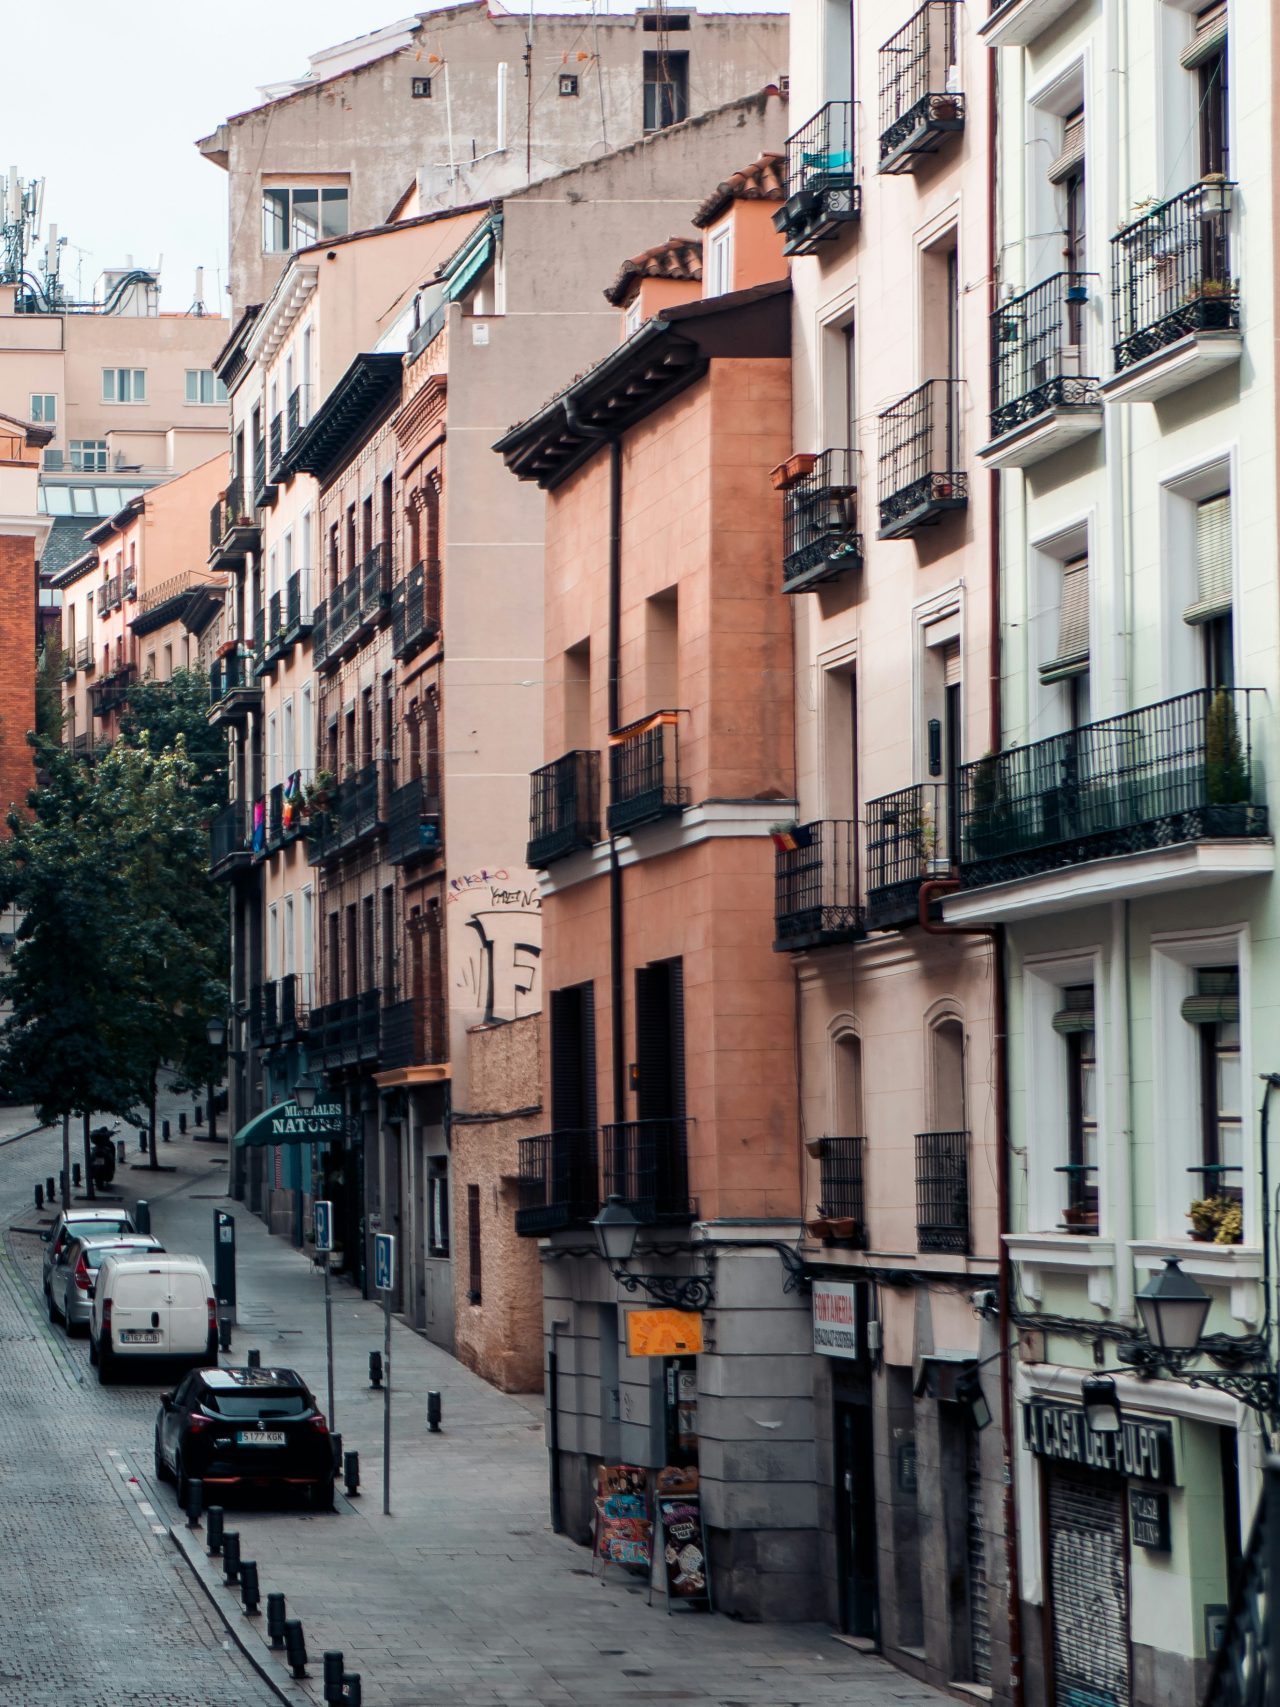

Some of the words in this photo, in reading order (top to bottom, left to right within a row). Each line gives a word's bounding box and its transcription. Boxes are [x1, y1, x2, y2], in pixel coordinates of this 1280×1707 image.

[219, 1214, 227, 1223] P
[243, 1432, 265, 1441] 5177
[1022, 1404, 1039, 1452] LA
[1042, 1408, 1082, 1463] CASA
[1114, 1424, 1160, 1479] PULPO
